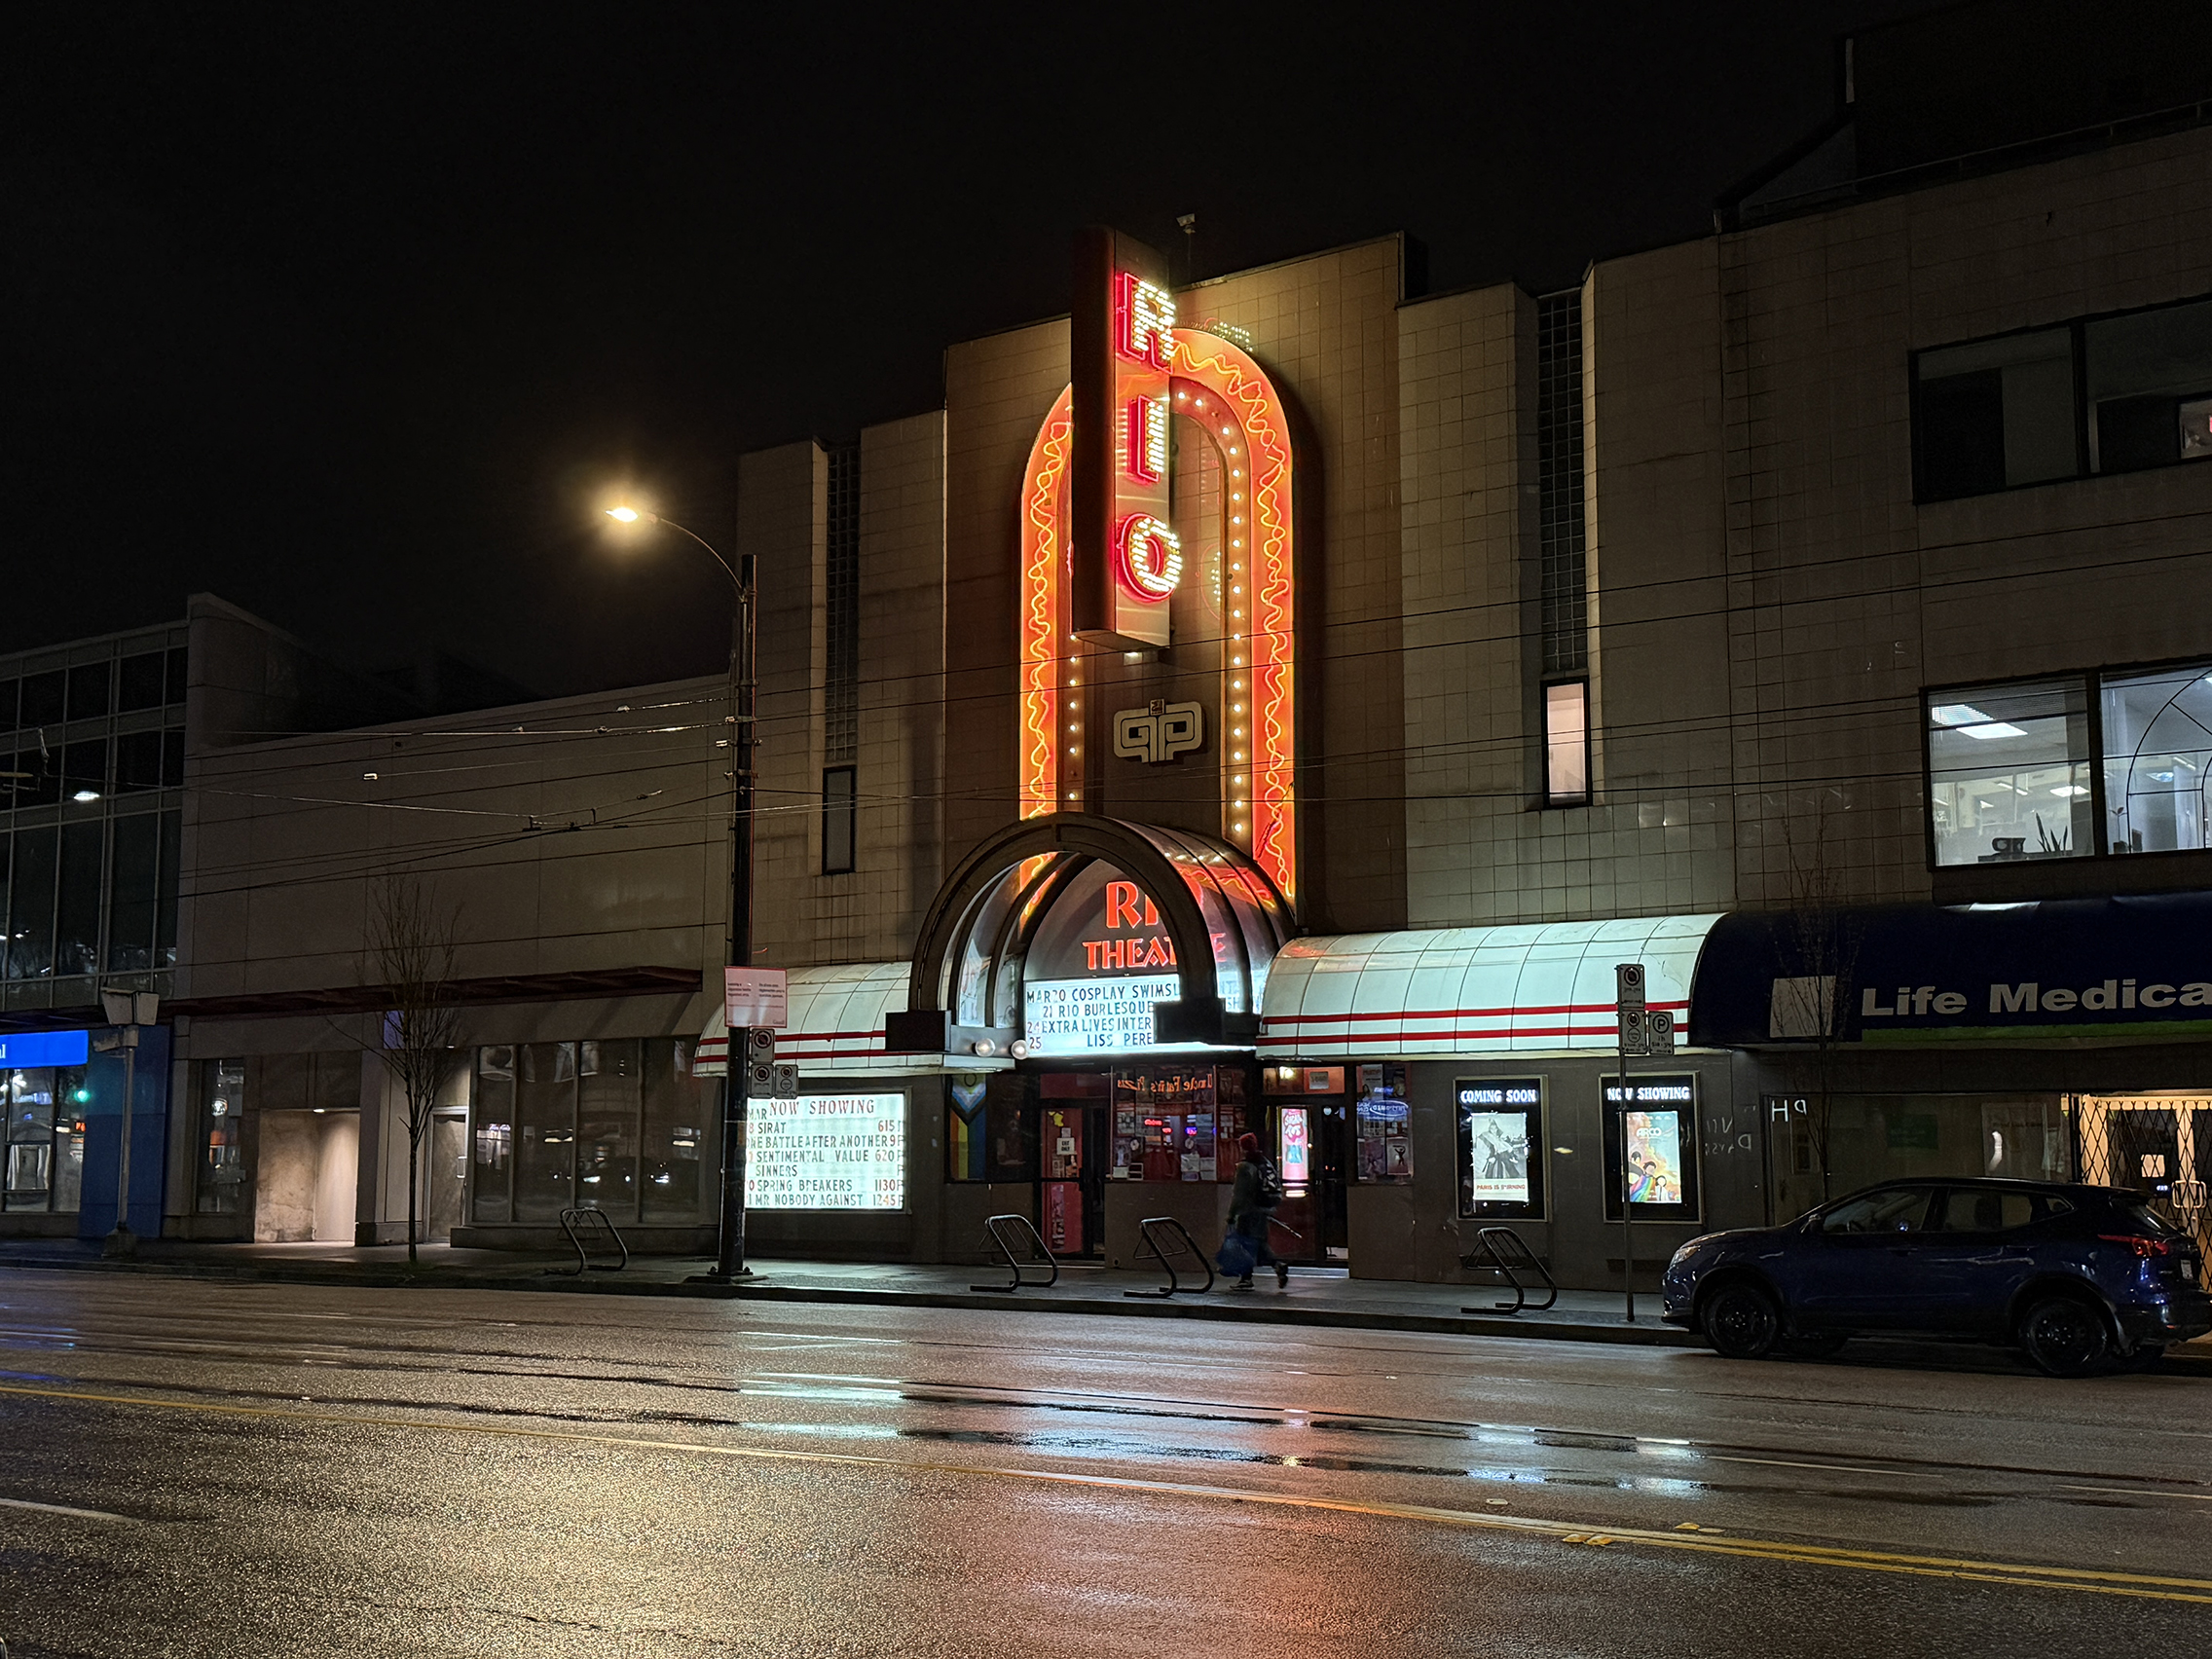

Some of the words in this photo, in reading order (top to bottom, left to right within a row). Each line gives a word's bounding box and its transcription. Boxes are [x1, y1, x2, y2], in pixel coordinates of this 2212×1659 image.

[1115, 272, 1182, 602] RIO
[1072, 985, 1125, 1002] COSPLAY
[1862, 985, 1968, 1016] Life
[1043, 1005, 1052, 1018] 21
[1058, 1004, 1079, 1018] RIO
[1085, 1000, 1154, 1016] BURLESQUE
[1042, 1019, 1079, 1034] EXTRA
[1082, 1017, 1115, 1033] LIVES
[1117, 1016, 1152, 1031] INTER
[1029, 1036, 1042, 1050] 25
[1087, 1033, 1114, 1048] LISS
[1459, 1089, 1503, 1103] COMING
[1505, 1088, 1537, 1103] SOON
[1637, 1086, 1690, 1100] SHOWING
[769, 1101, 799, 1116] NOW
[809, 1098, 874, 1115] SHOWING
[757, 1122, 787, 1134] SIRAT
[877, 1120, 896, 1132] 615
[839, 1134, 888, 1148] ANOTHER
[756, 1150, 825, 1162] SENTIMENTAL
[834, 1149, 869, 1162] VALUE
[756, 1164, 798, 1177] SINNERS
[746, 1179, 755, 1192] 0
[756, 1179, 793, 1192] SPRING
[755, 1194, 770, 1206] MR
[774, 1193, 816, 1206] NOBODY
[819, 1194, 864, 1206] AGAINST
